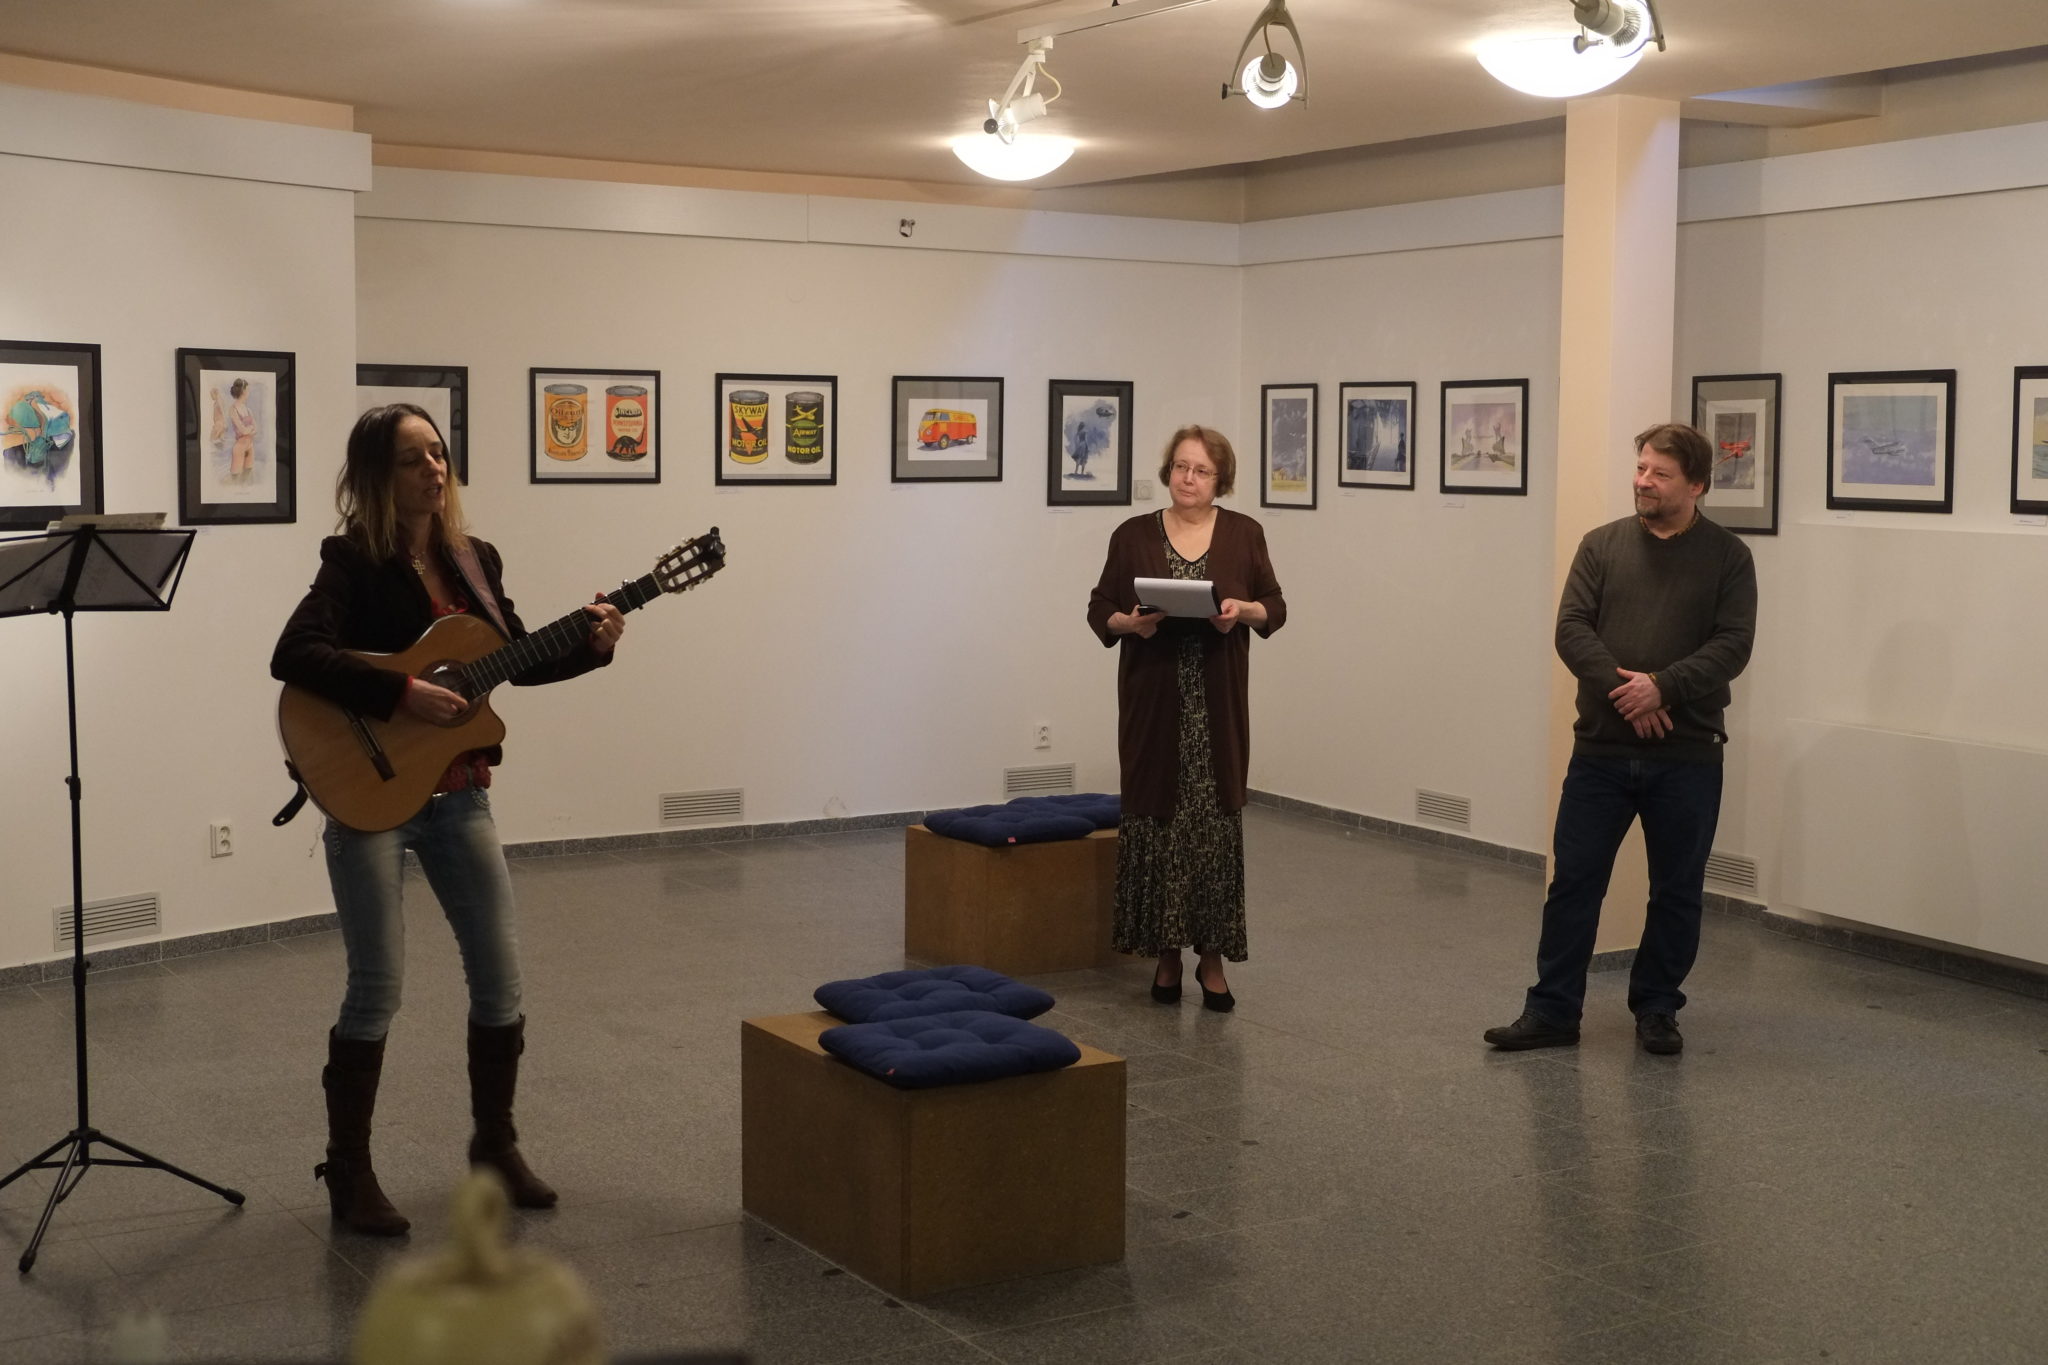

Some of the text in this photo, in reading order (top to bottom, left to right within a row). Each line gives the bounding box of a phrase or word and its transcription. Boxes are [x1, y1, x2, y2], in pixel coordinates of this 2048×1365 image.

[734, 405, 766, 414] SKYWAY
[732, 438, 767, 447] MOTOR OIL
[788, 445, 821, 454] MOTOR OIL
